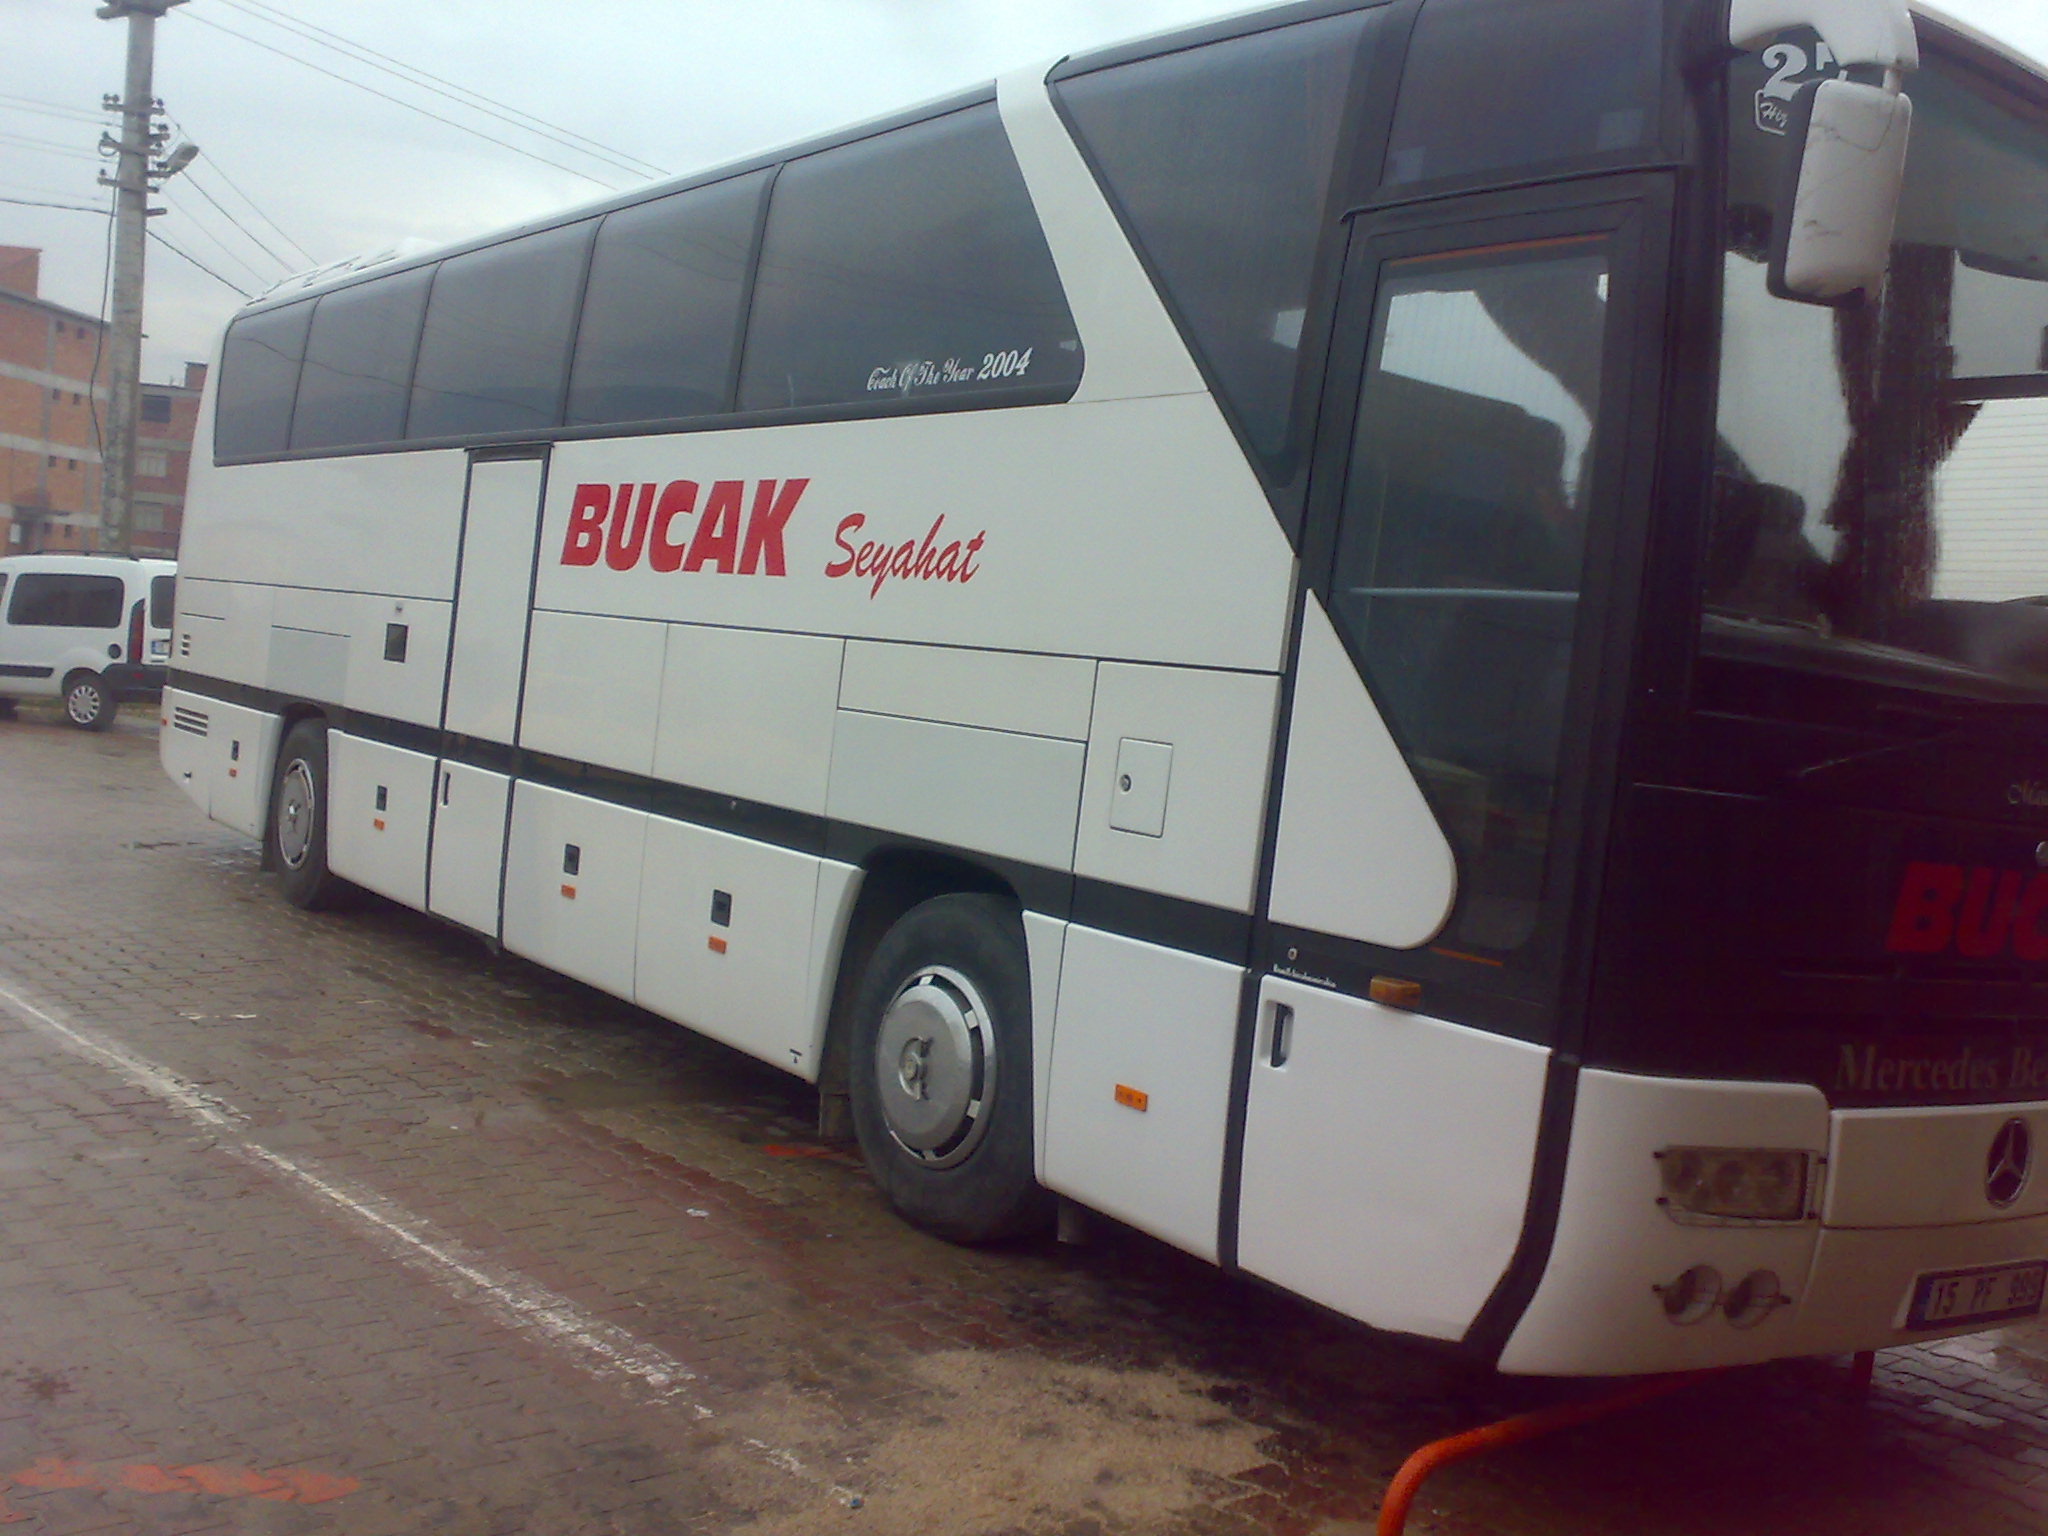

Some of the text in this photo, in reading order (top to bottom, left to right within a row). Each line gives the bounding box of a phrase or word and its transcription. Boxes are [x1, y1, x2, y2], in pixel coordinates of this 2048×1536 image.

[914, 360, 939, 387] The
[943, 358, 975, 383] Year
[977, 347, 1033, 380] 2004
[560, 478, 986, 600] BUCAK Seyahat
[1836, 1043, 1998, 1090] Mercedes
